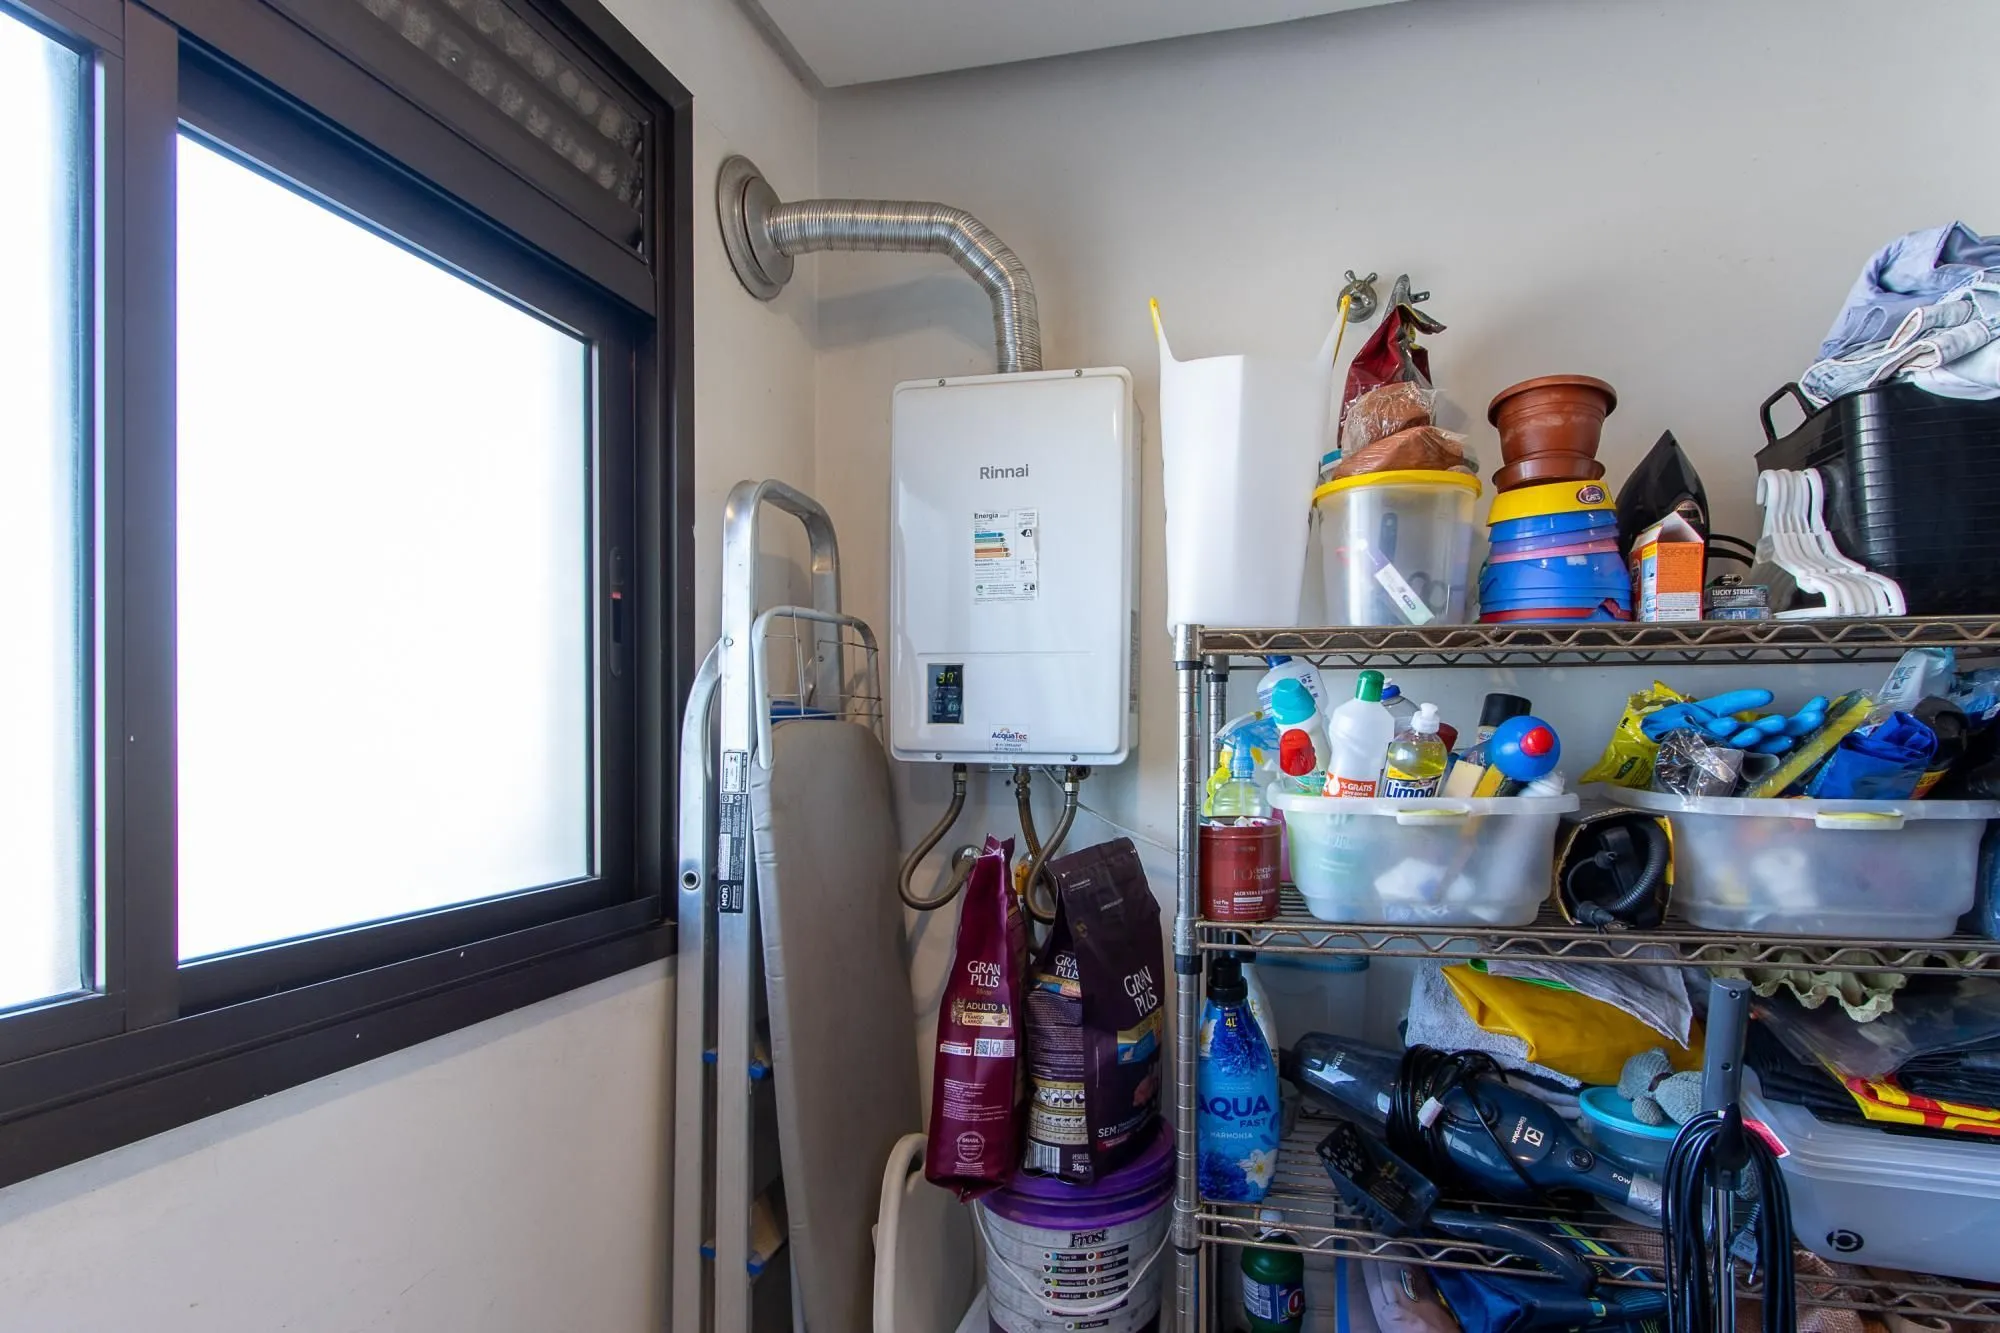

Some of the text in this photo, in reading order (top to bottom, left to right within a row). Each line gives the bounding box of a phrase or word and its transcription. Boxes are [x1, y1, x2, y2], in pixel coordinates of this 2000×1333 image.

[980, 463, 1028, 480] Rinnai
[974, 512, 999, 520] Energia
[1712, 588, 1754, 596] LUCKY STRIKE
[992, 731, 1027, 741] AcquaTec
[1347, 782, 1373, 792] GRÁTIS
[721, 887, 729, 906] MOR
[967, 960, 1001, 977] GRAN
[1055, 954, 1079, 969] GRA
[1056, 965, 1080, 980] PLUS
[970, 974, 1000, 988] PLUS
[966, 1001, 998, 1011] ADULTO
[1134, 986, 1158, 1017] PLUS
[1199, 1094, 1272, 1121] AQUA
[1240, 1117, 1266, 1128] FAST
[1511, 1115, 1527, 1144] Electrolux
[1098, 1125, 1117, 1138] SEM
[1210, 1131, 1253, 1140] HARMONIA
[1069, 1229, 1106, 1248] Frost
